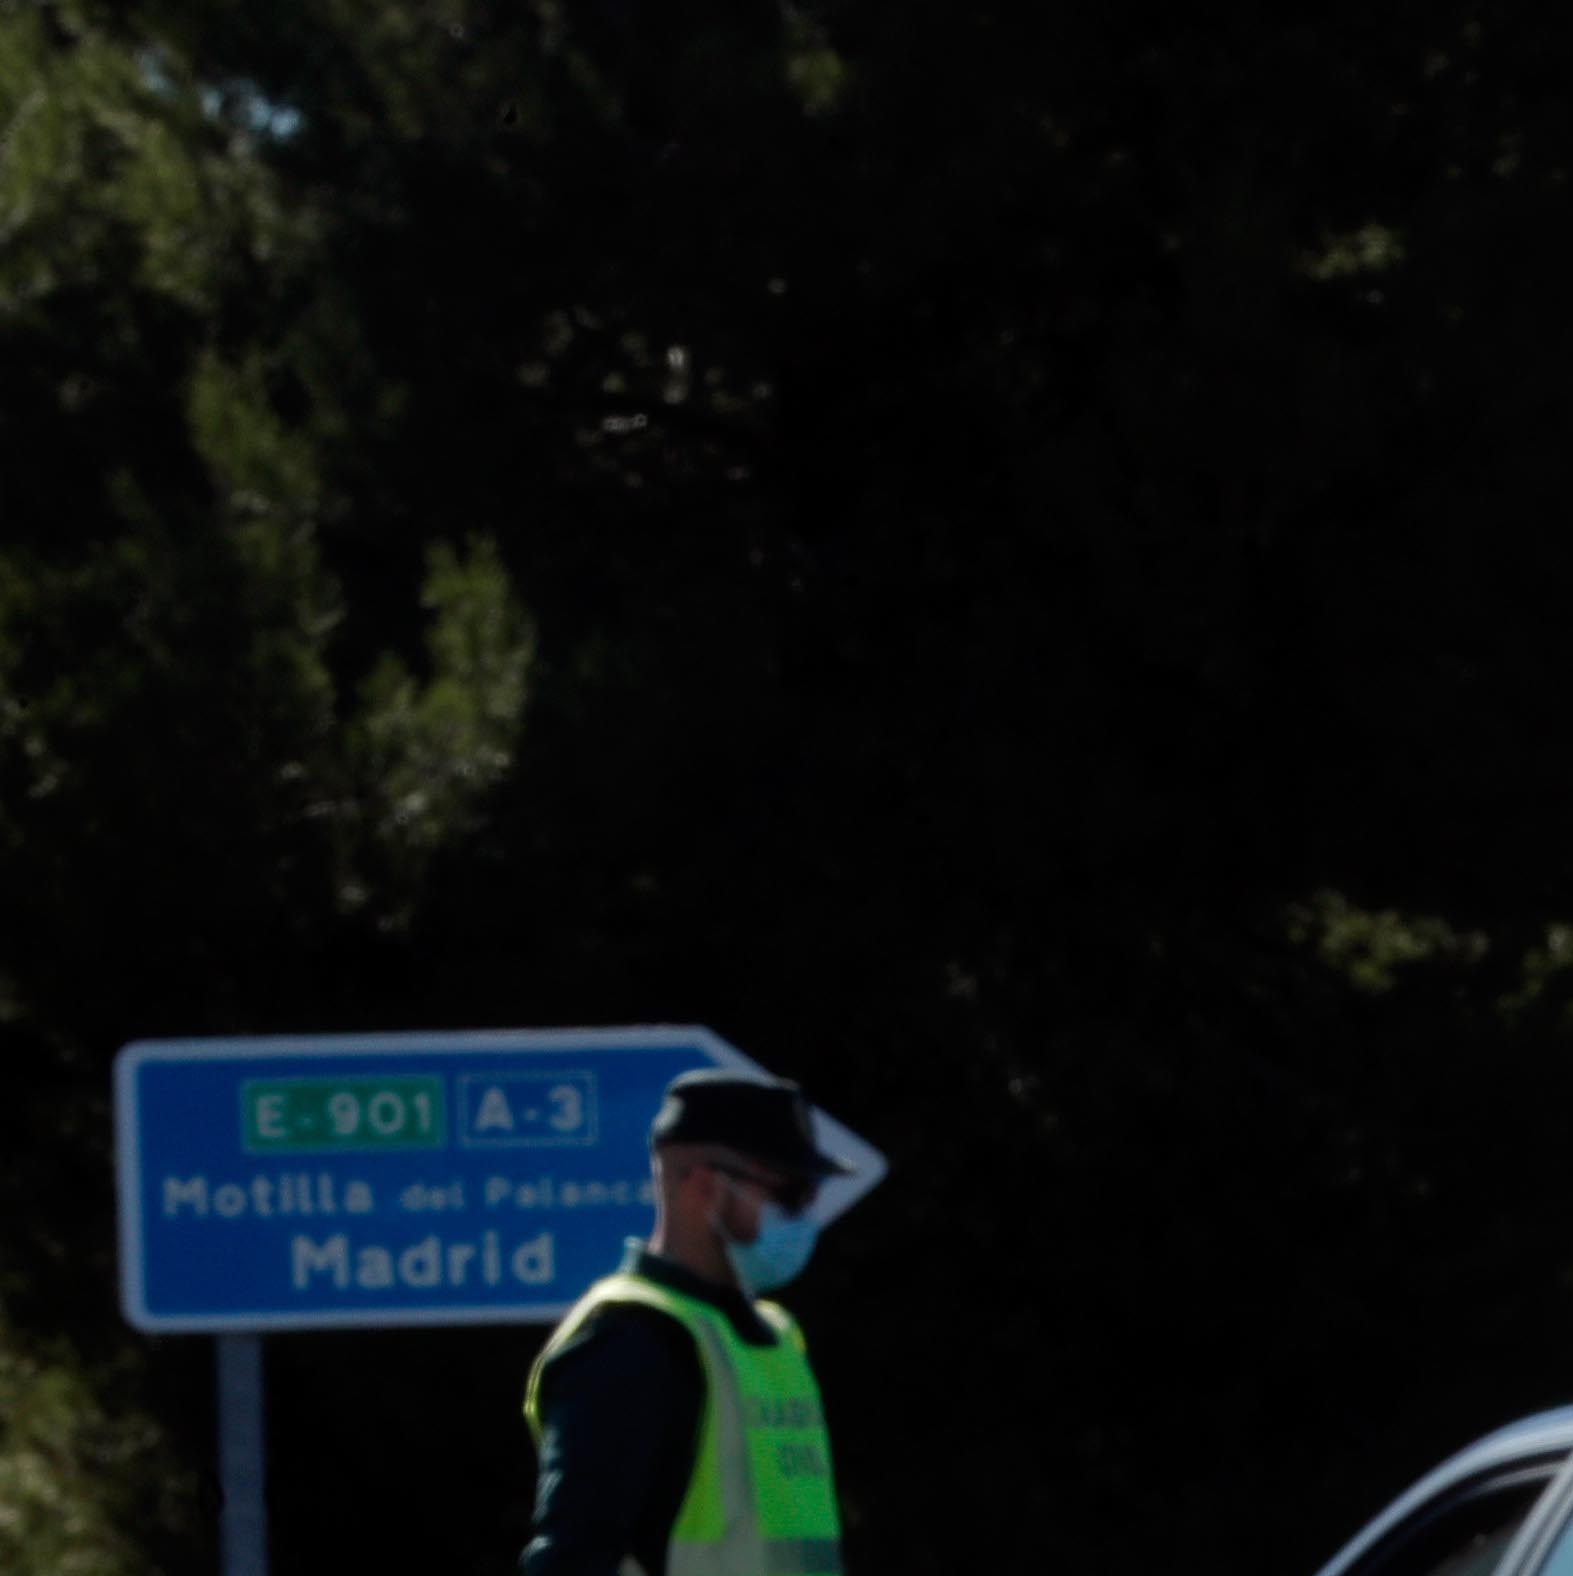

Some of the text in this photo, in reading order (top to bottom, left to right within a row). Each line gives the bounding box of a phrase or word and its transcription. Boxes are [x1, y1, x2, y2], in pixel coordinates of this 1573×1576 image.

[254, 1091, 432, 1139] E-901
[473, 1084, 584, 1132] A-3
[162, 1171, 374, 1219] Motilla
[290, 1229, 555, 1290] Madrid
